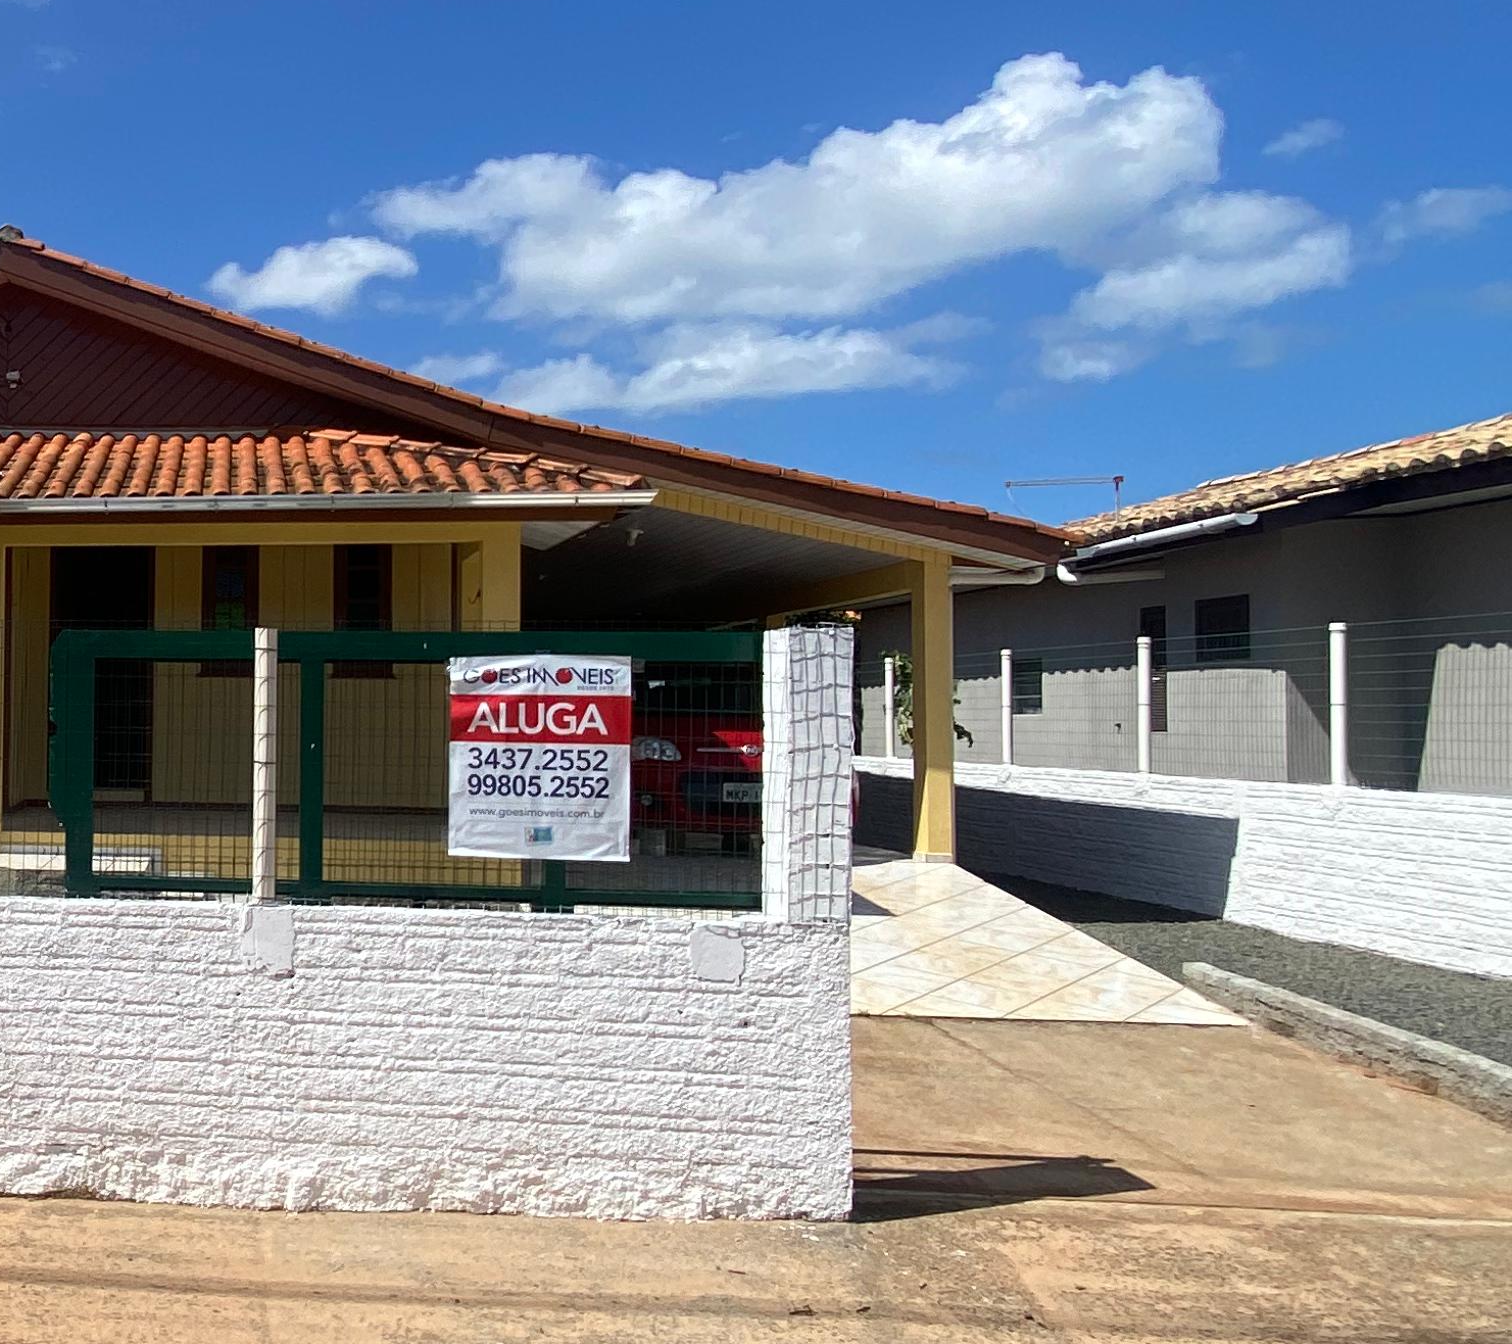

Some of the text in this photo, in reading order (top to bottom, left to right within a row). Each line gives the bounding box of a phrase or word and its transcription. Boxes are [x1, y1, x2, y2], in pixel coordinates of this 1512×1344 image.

[463, 667, 521, 684] GOES
[467, 702, 608, 736] ALUGA
[467, 747, 608, 772] 3437.2552
[467, 774, 610, 799] 99805.2552
[468, 808, 605, 819] www.goesimoveis.com.br
